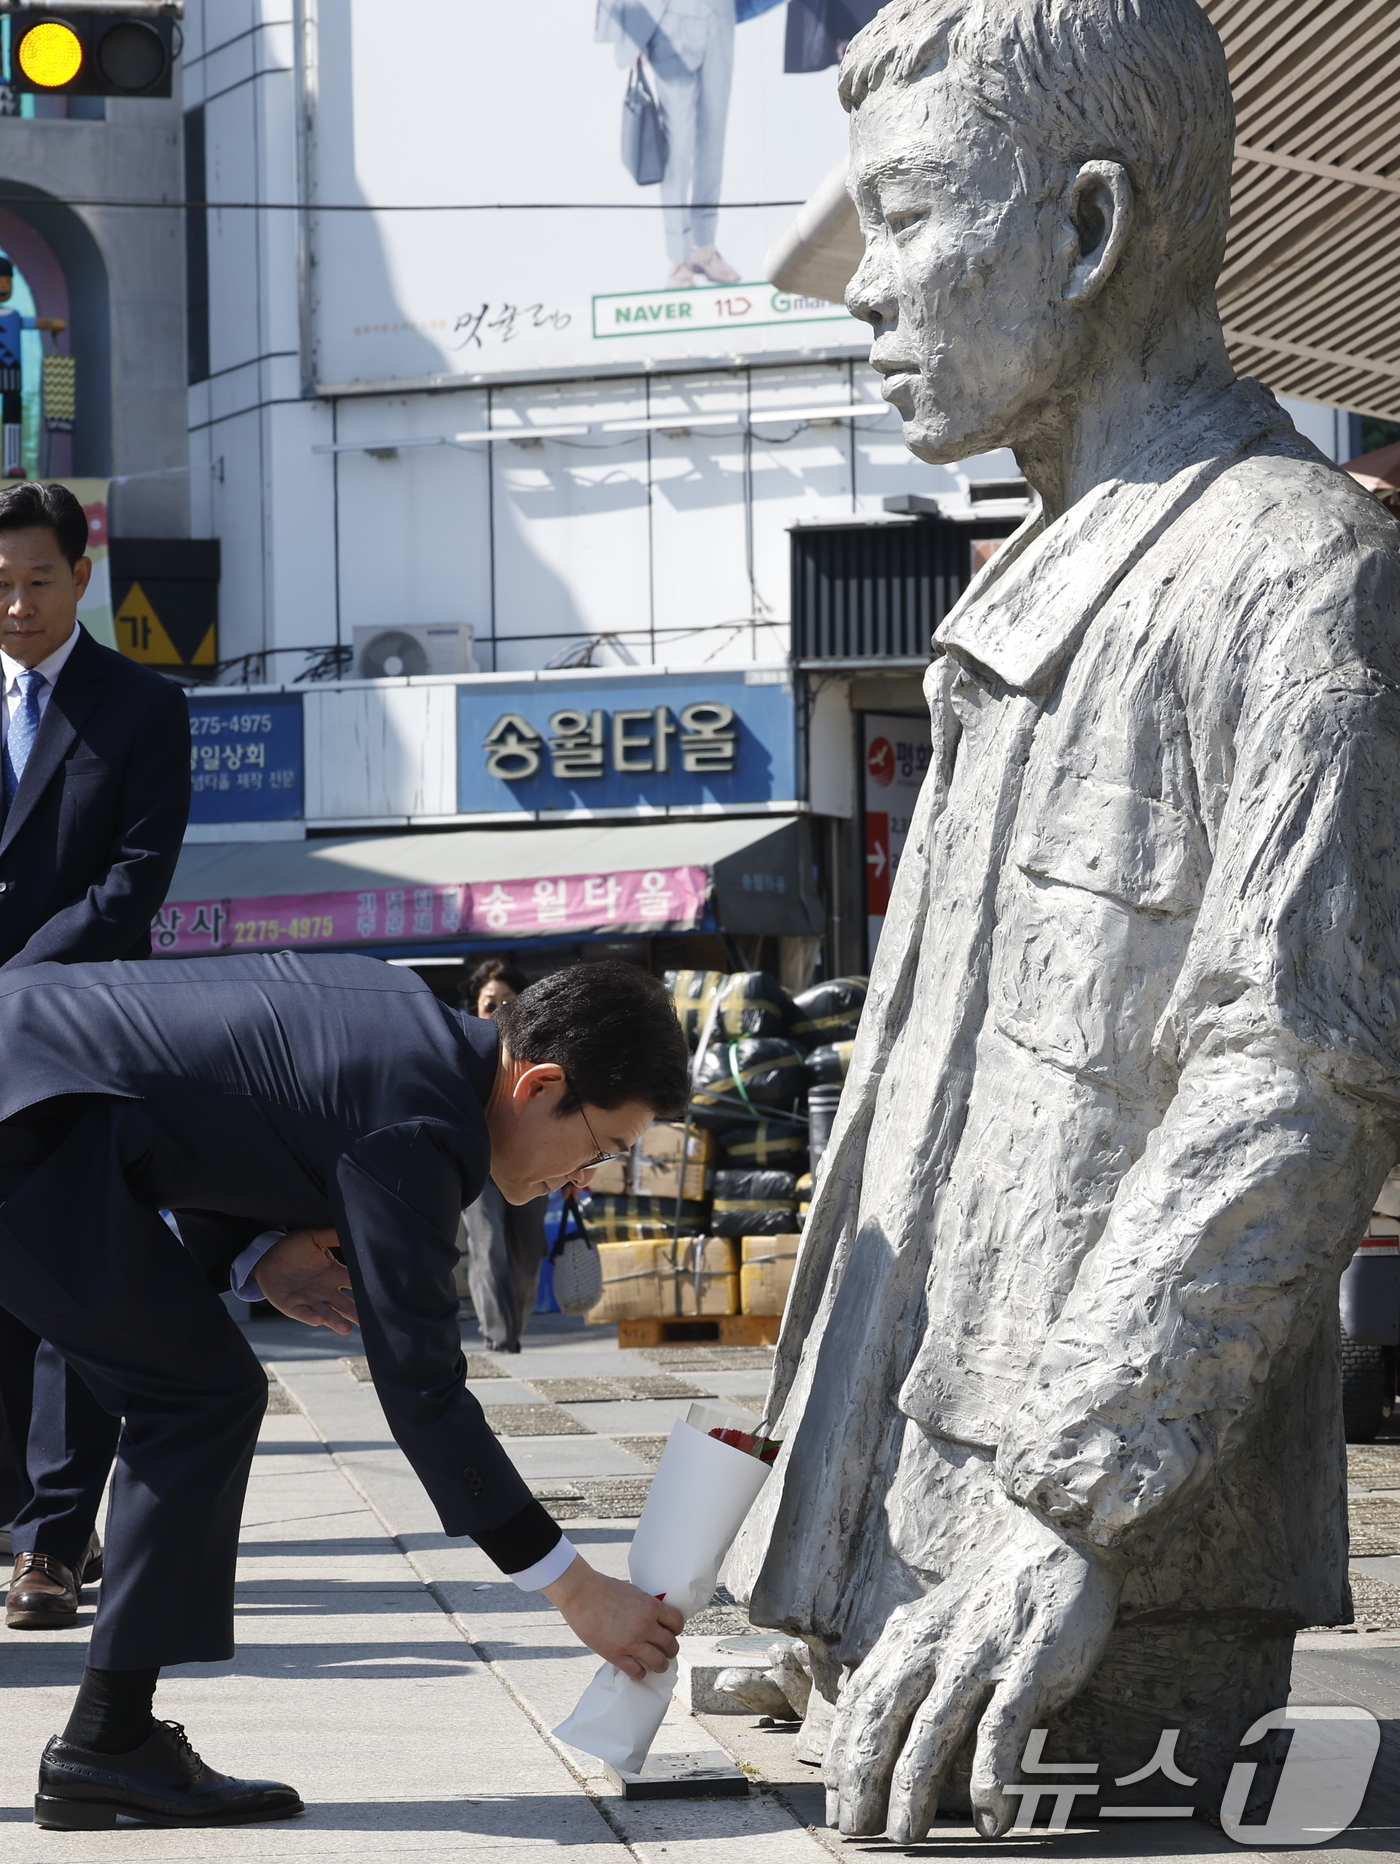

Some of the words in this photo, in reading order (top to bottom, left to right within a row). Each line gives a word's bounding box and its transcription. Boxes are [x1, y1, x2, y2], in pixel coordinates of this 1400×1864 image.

[615, 303, 692, 323] NAVER
[119, 616, 152, 650] 가
[484, 701, 737, 780] 송월타올
[478, 870, 674, 929] 송월타올
[235, 916, 333, 942] 2275-4975
